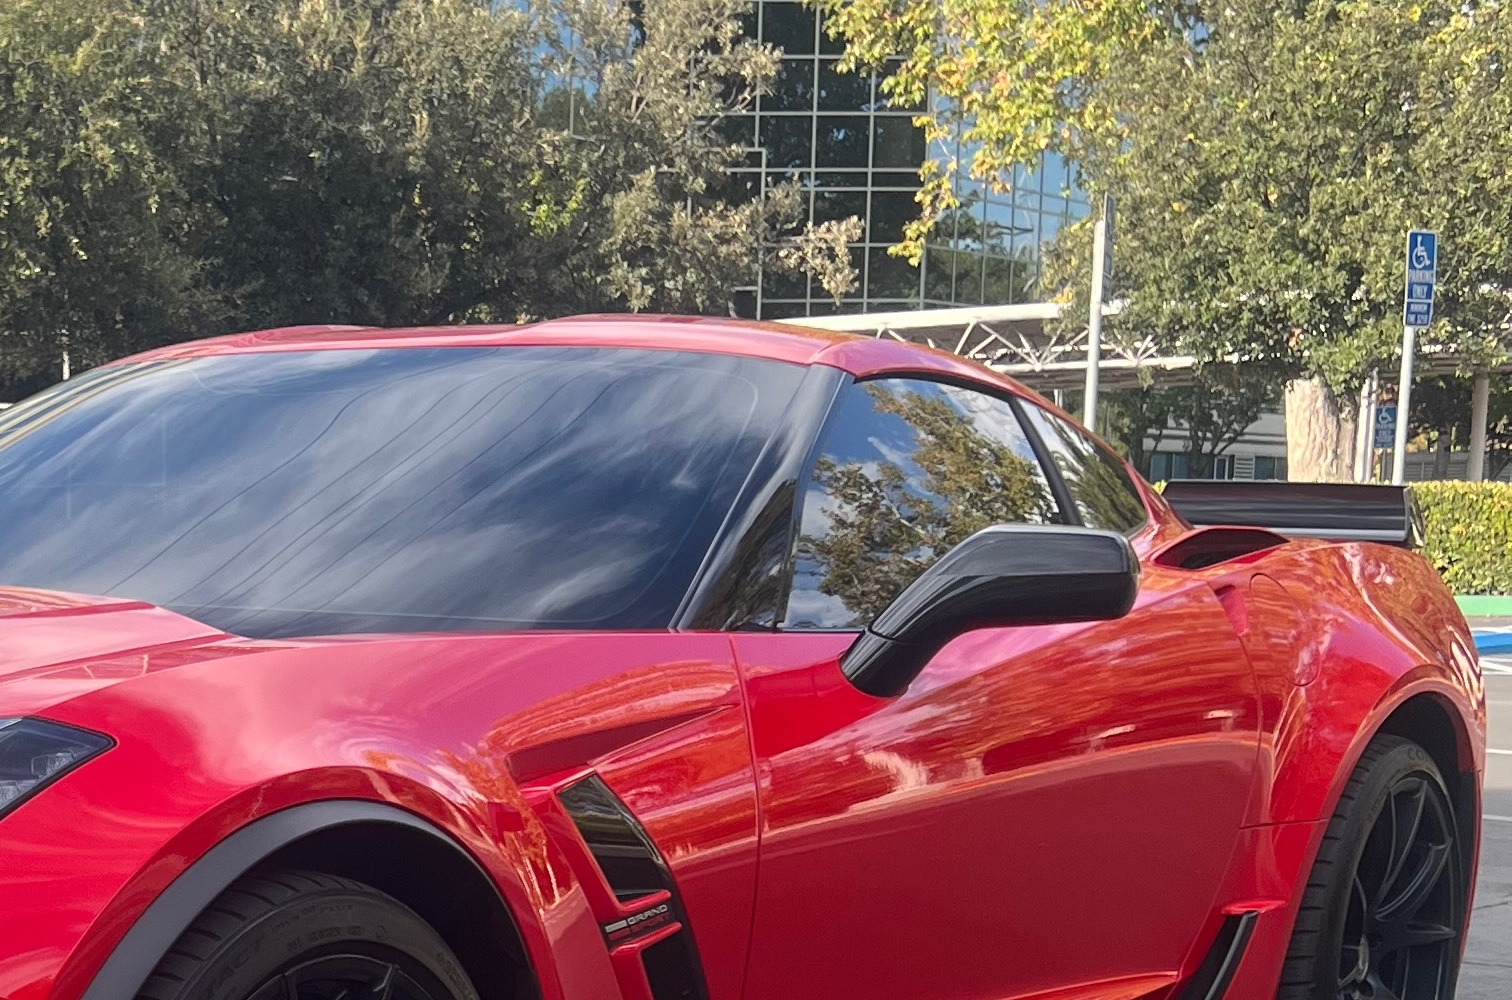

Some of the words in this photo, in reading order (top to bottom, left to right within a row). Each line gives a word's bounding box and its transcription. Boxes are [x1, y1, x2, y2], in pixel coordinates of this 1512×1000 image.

[1408, 269, 1434, 283] PARKING
[1412, 284, 1428, 298] ONLY
[627, 904, 668, 925] GRAND
